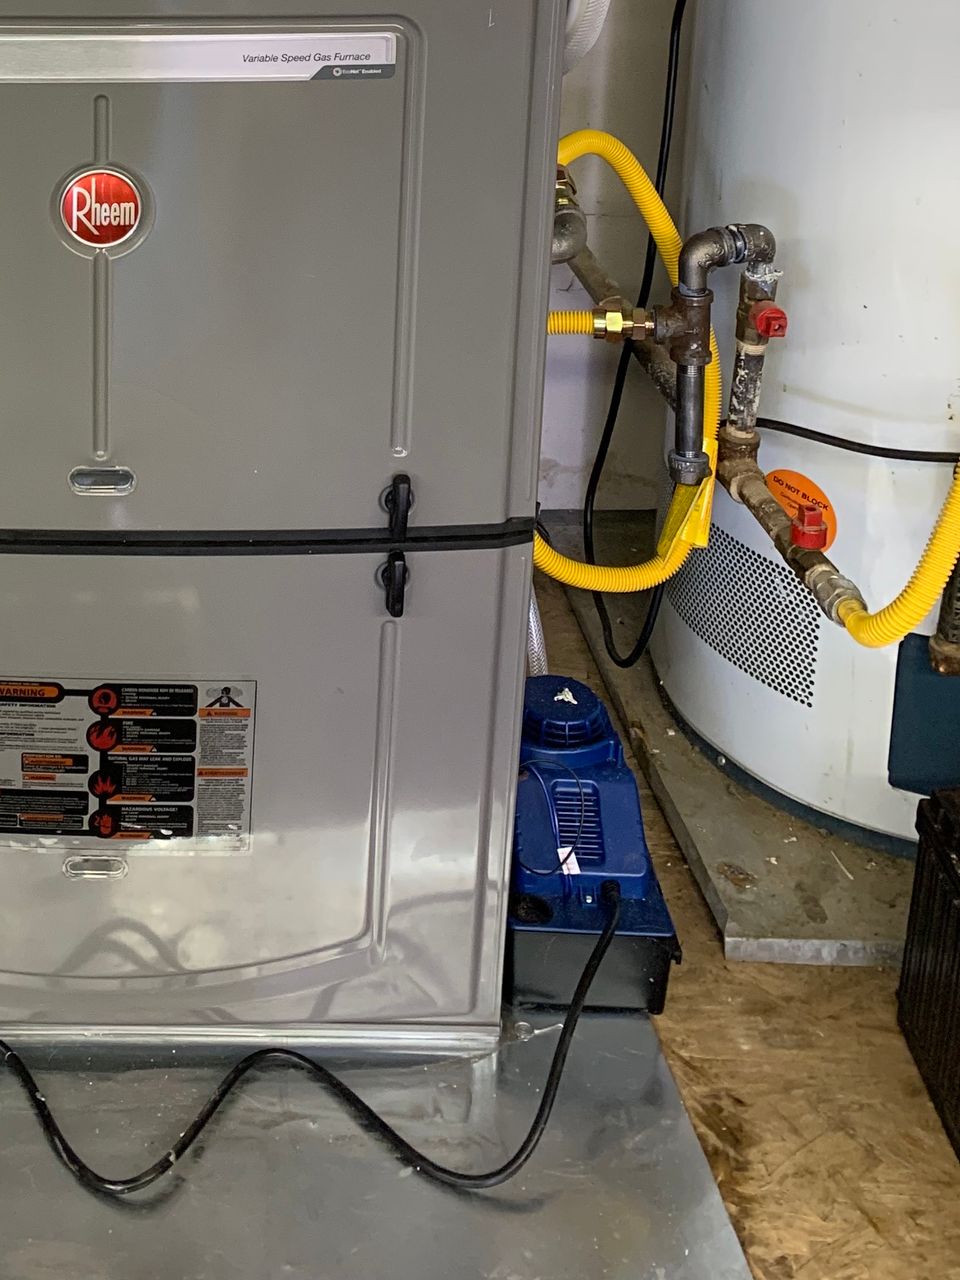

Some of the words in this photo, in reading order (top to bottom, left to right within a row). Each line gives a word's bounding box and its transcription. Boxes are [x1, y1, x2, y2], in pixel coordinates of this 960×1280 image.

[242, 54, 278, 62] Variable
[281, 53, 311, 63] Speed
[313, 53, 331, 62] Gas
[334, 52, 370, 61] Furnace
[72, 177, 135, 236] Rheem
[773, 476, 784, 486] DO
[785, 483, 800, 495] NOT
[801, 492, 829, 511] BLOCK
